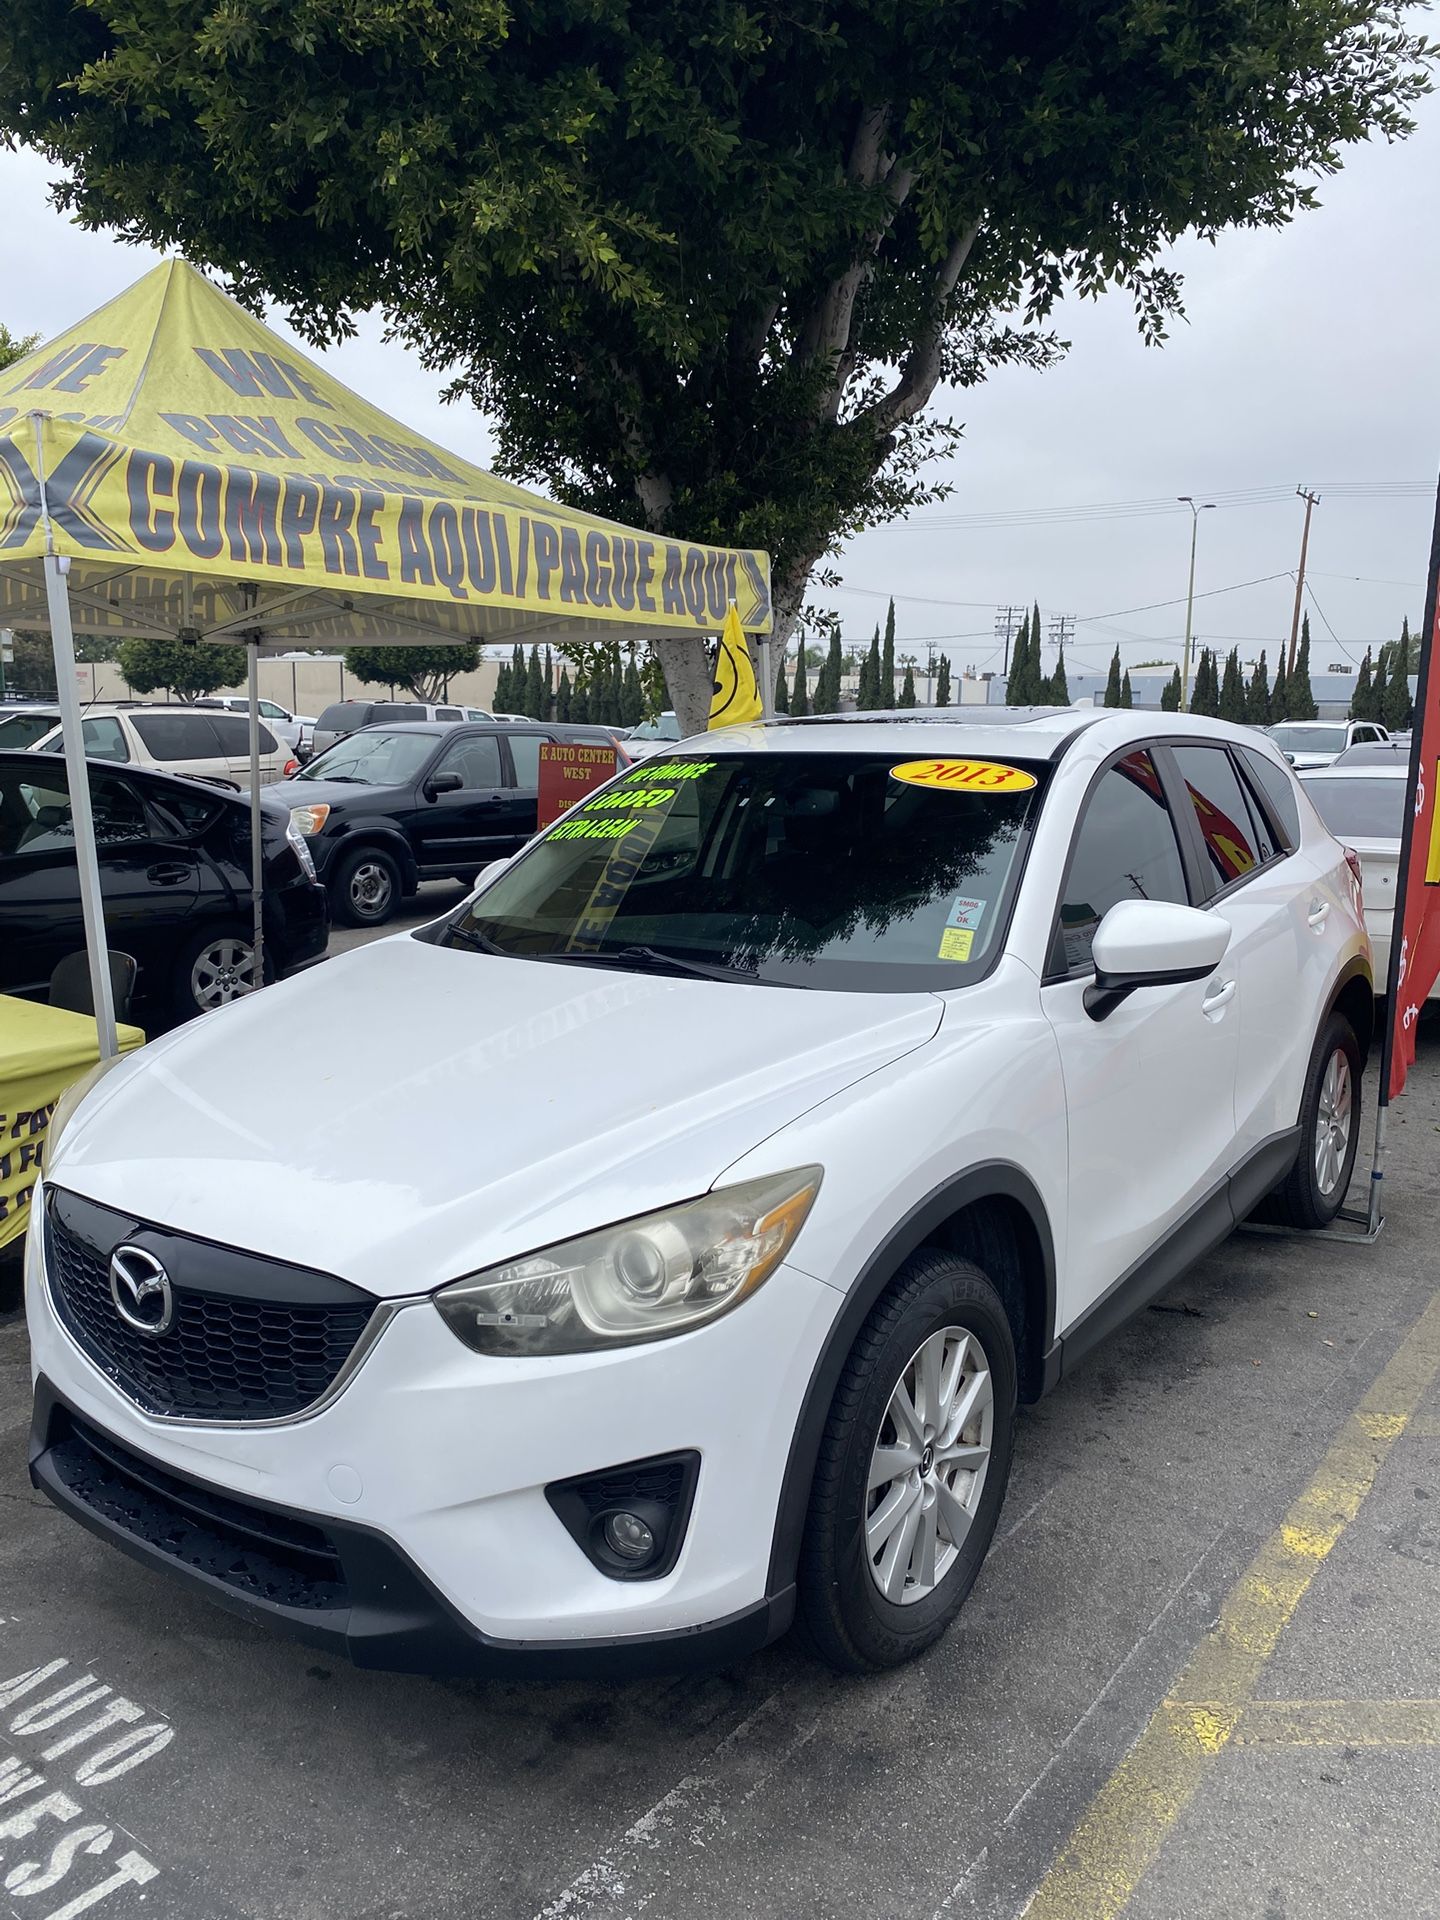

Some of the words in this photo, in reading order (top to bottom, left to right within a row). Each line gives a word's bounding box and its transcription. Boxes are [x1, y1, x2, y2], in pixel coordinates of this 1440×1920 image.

[192, 347, 337, 411] WE
[158, 412, 305, 460] PAY
[295, 417, 469, 485] CASH
[127, 448, 390, 580] COMPRE
[662, 544, 738, 626] AQUI
[541, 746, 549, 761] K
[550, 747, 576, 762] AUTO
[578, 748, 616, 765] CENTER
[563, 766, 592, 781] WEST
[643, 762, 718, 781] FINANCE
[910, 763, 1015, 786] 2013
[583, 788, 676, 812] LOADED
[546, 819, 591, 842] EXTRA
[583, 818, 643, 839] CLEAN
[958, 899, 980, 909] SMOG
[956, 916, 969, 924] OK
[0, 1657, 175, 1787] AUTO
